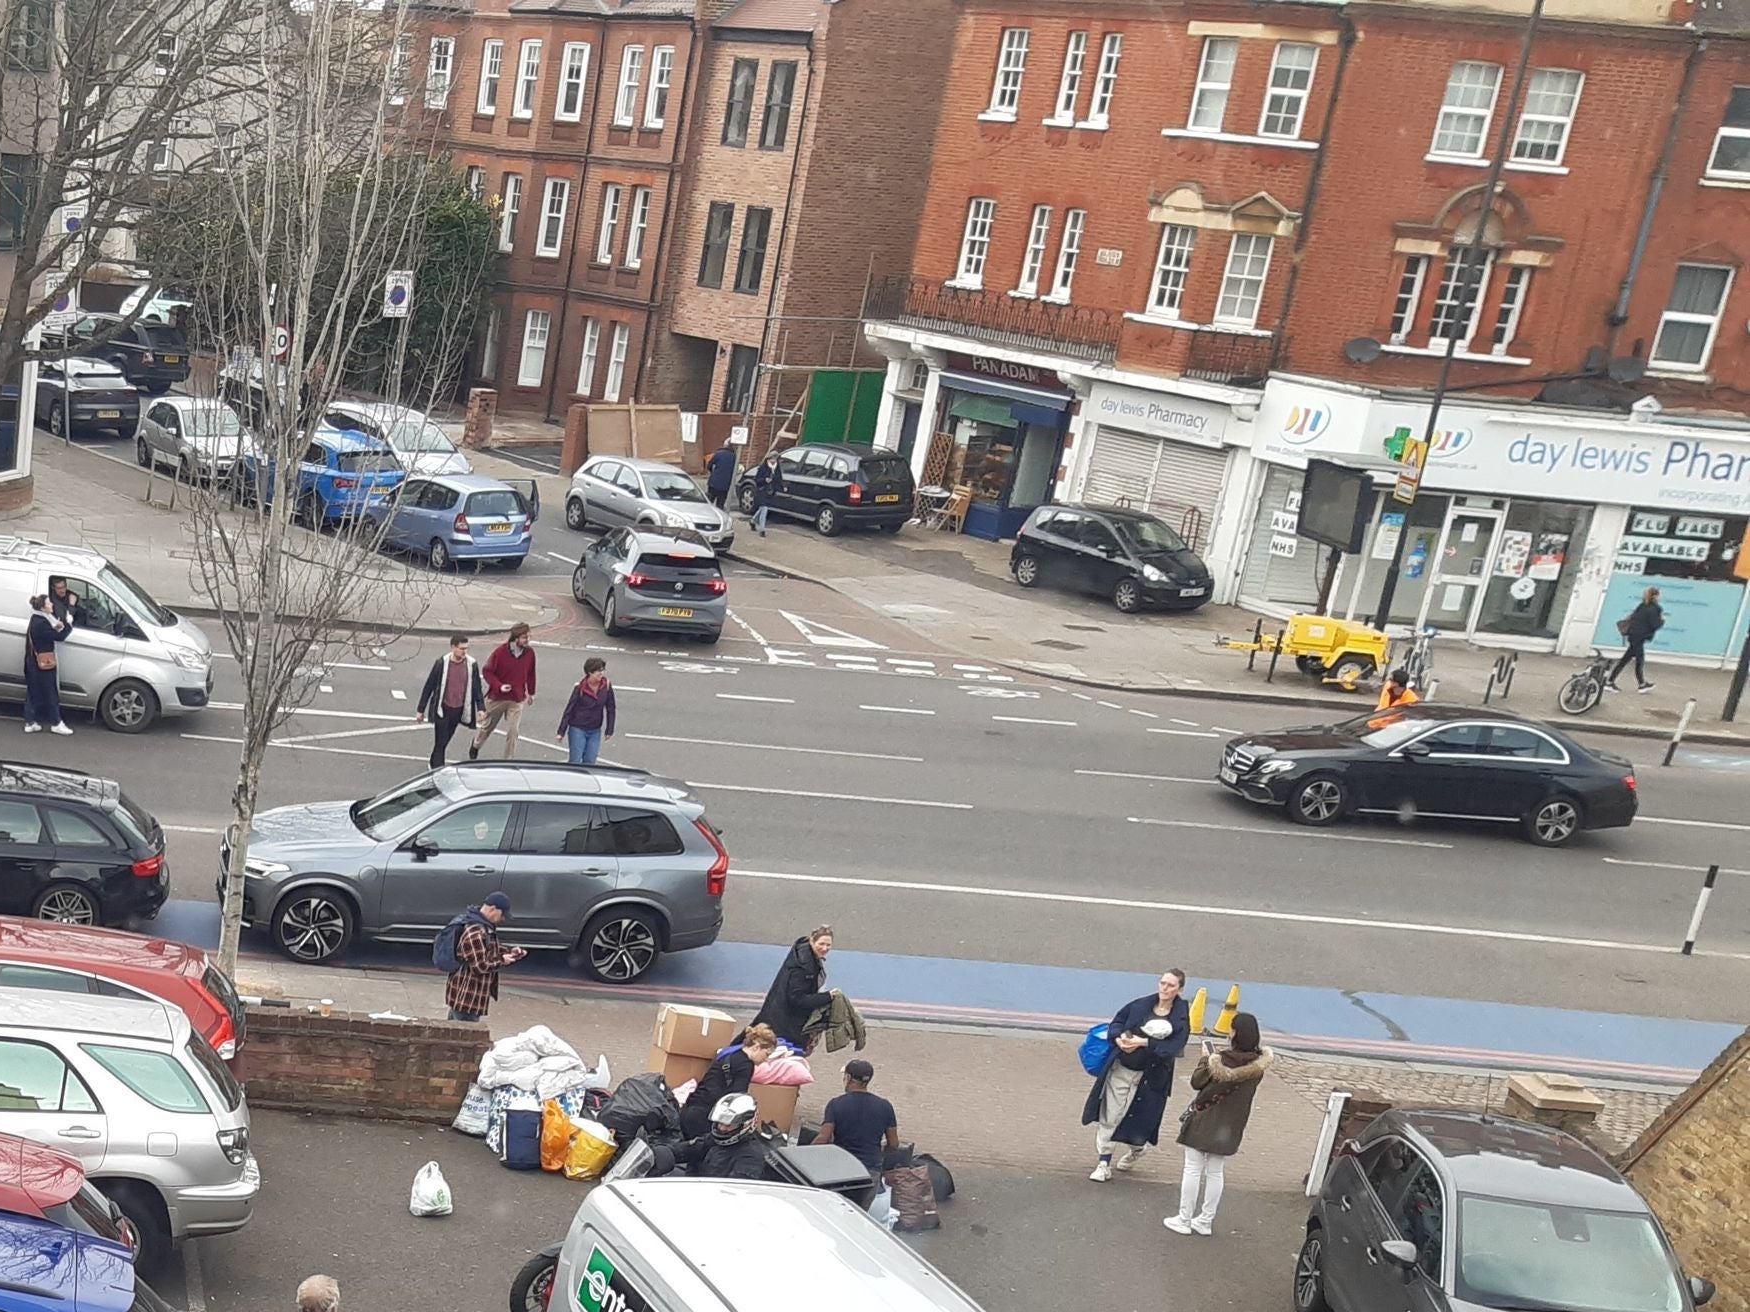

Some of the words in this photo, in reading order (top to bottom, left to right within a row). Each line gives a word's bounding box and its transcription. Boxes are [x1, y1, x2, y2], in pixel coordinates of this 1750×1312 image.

[1101, 397, 1118, 415] day
[1120, 401, 1144, 416] lewis
[1148, 404, 1208, 432] Pharmacy
[1508, 434, 1567, 473] day
[1571, 438, 1652, 474] lewis
[1661, 441, 1750, 483] Phar
[1288, 498, 1300, 509] FL
[1272, 515, 1296, 531] AVA
[1634, 517, 1669, 531] FLU
[1677, 520, 1721, 536] JABS
[1271, 541, 1294, 554] NHS
[1620, 541, 1707, 558] AVAILABLE
[1613, 560, 1642, 572] NHS
